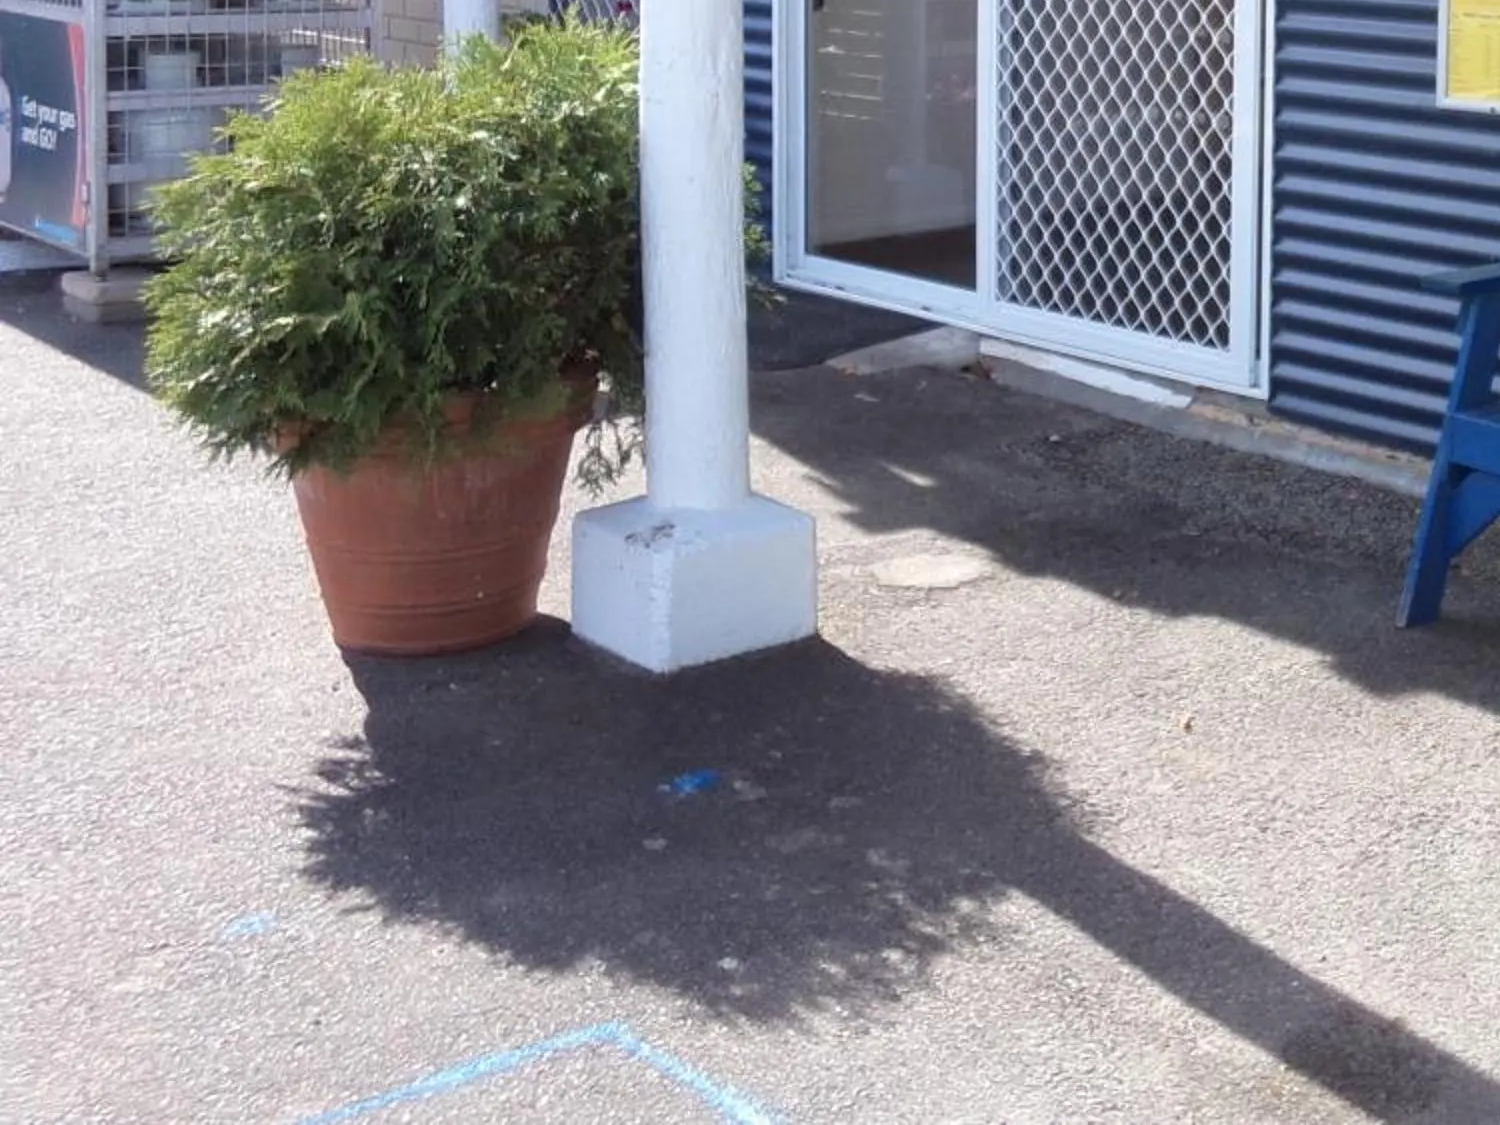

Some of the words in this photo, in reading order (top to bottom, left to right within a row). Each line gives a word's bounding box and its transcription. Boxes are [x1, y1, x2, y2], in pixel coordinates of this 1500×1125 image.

[22, 95, 37, 118] Get
[38, 105, 58, 125] your
[59, 110, 76, 131] gas
[22, 126, 38, 146] and
